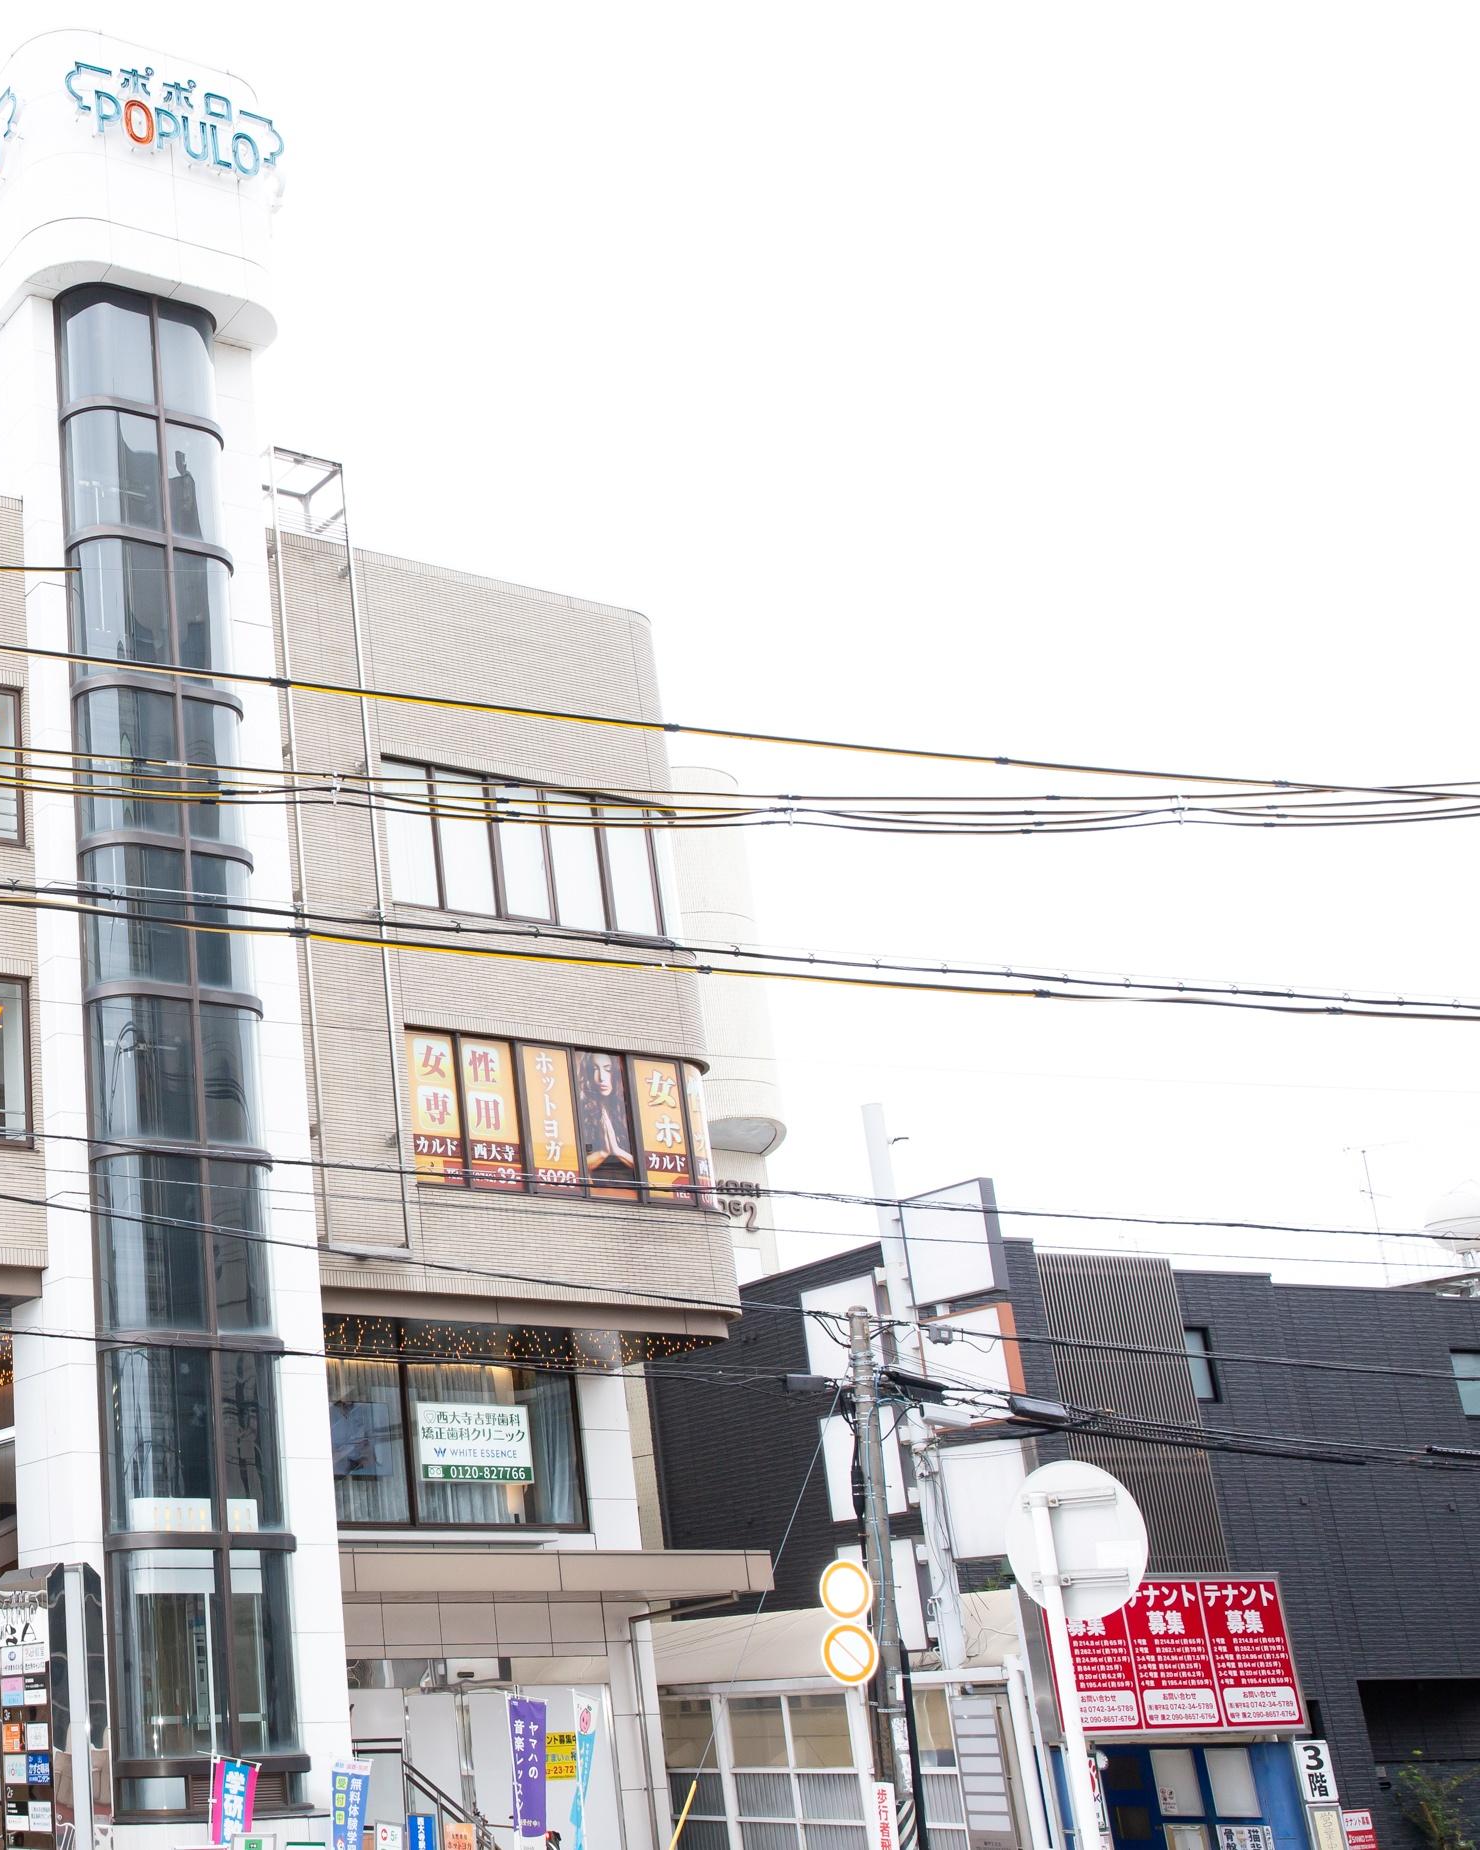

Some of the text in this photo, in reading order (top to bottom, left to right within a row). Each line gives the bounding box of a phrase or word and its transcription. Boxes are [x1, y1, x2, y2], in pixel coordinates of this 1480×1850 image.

[119, 66, 233, 122] ポポロ
[95, 90, 260, 177] POPULO
[535, 1051, 562, 1163] ホットヨガ
[416, 1136, 458, 1157] カルド
[473, 1142, 516, 1163] 西大寺
[648, 1152, 686, 1173] カルド
[421, 1425, 526, 1443] 矯正歯科クリニック
[450, 1448, 478, 1457] WHITE
[480, 1449, 517, 1459] ESSENCE
[450, 1465, 526, 1480] 0120-827766
[1203, 1583, 1275, 1608] テナント
[1146, 1609, 1186, 1636] 募集
[1224, 1609, 1264, 1634] 募集
[528, 1721, 539, 1780] ヤマハの
[1303, 1745, 1329, 1798] 3階
